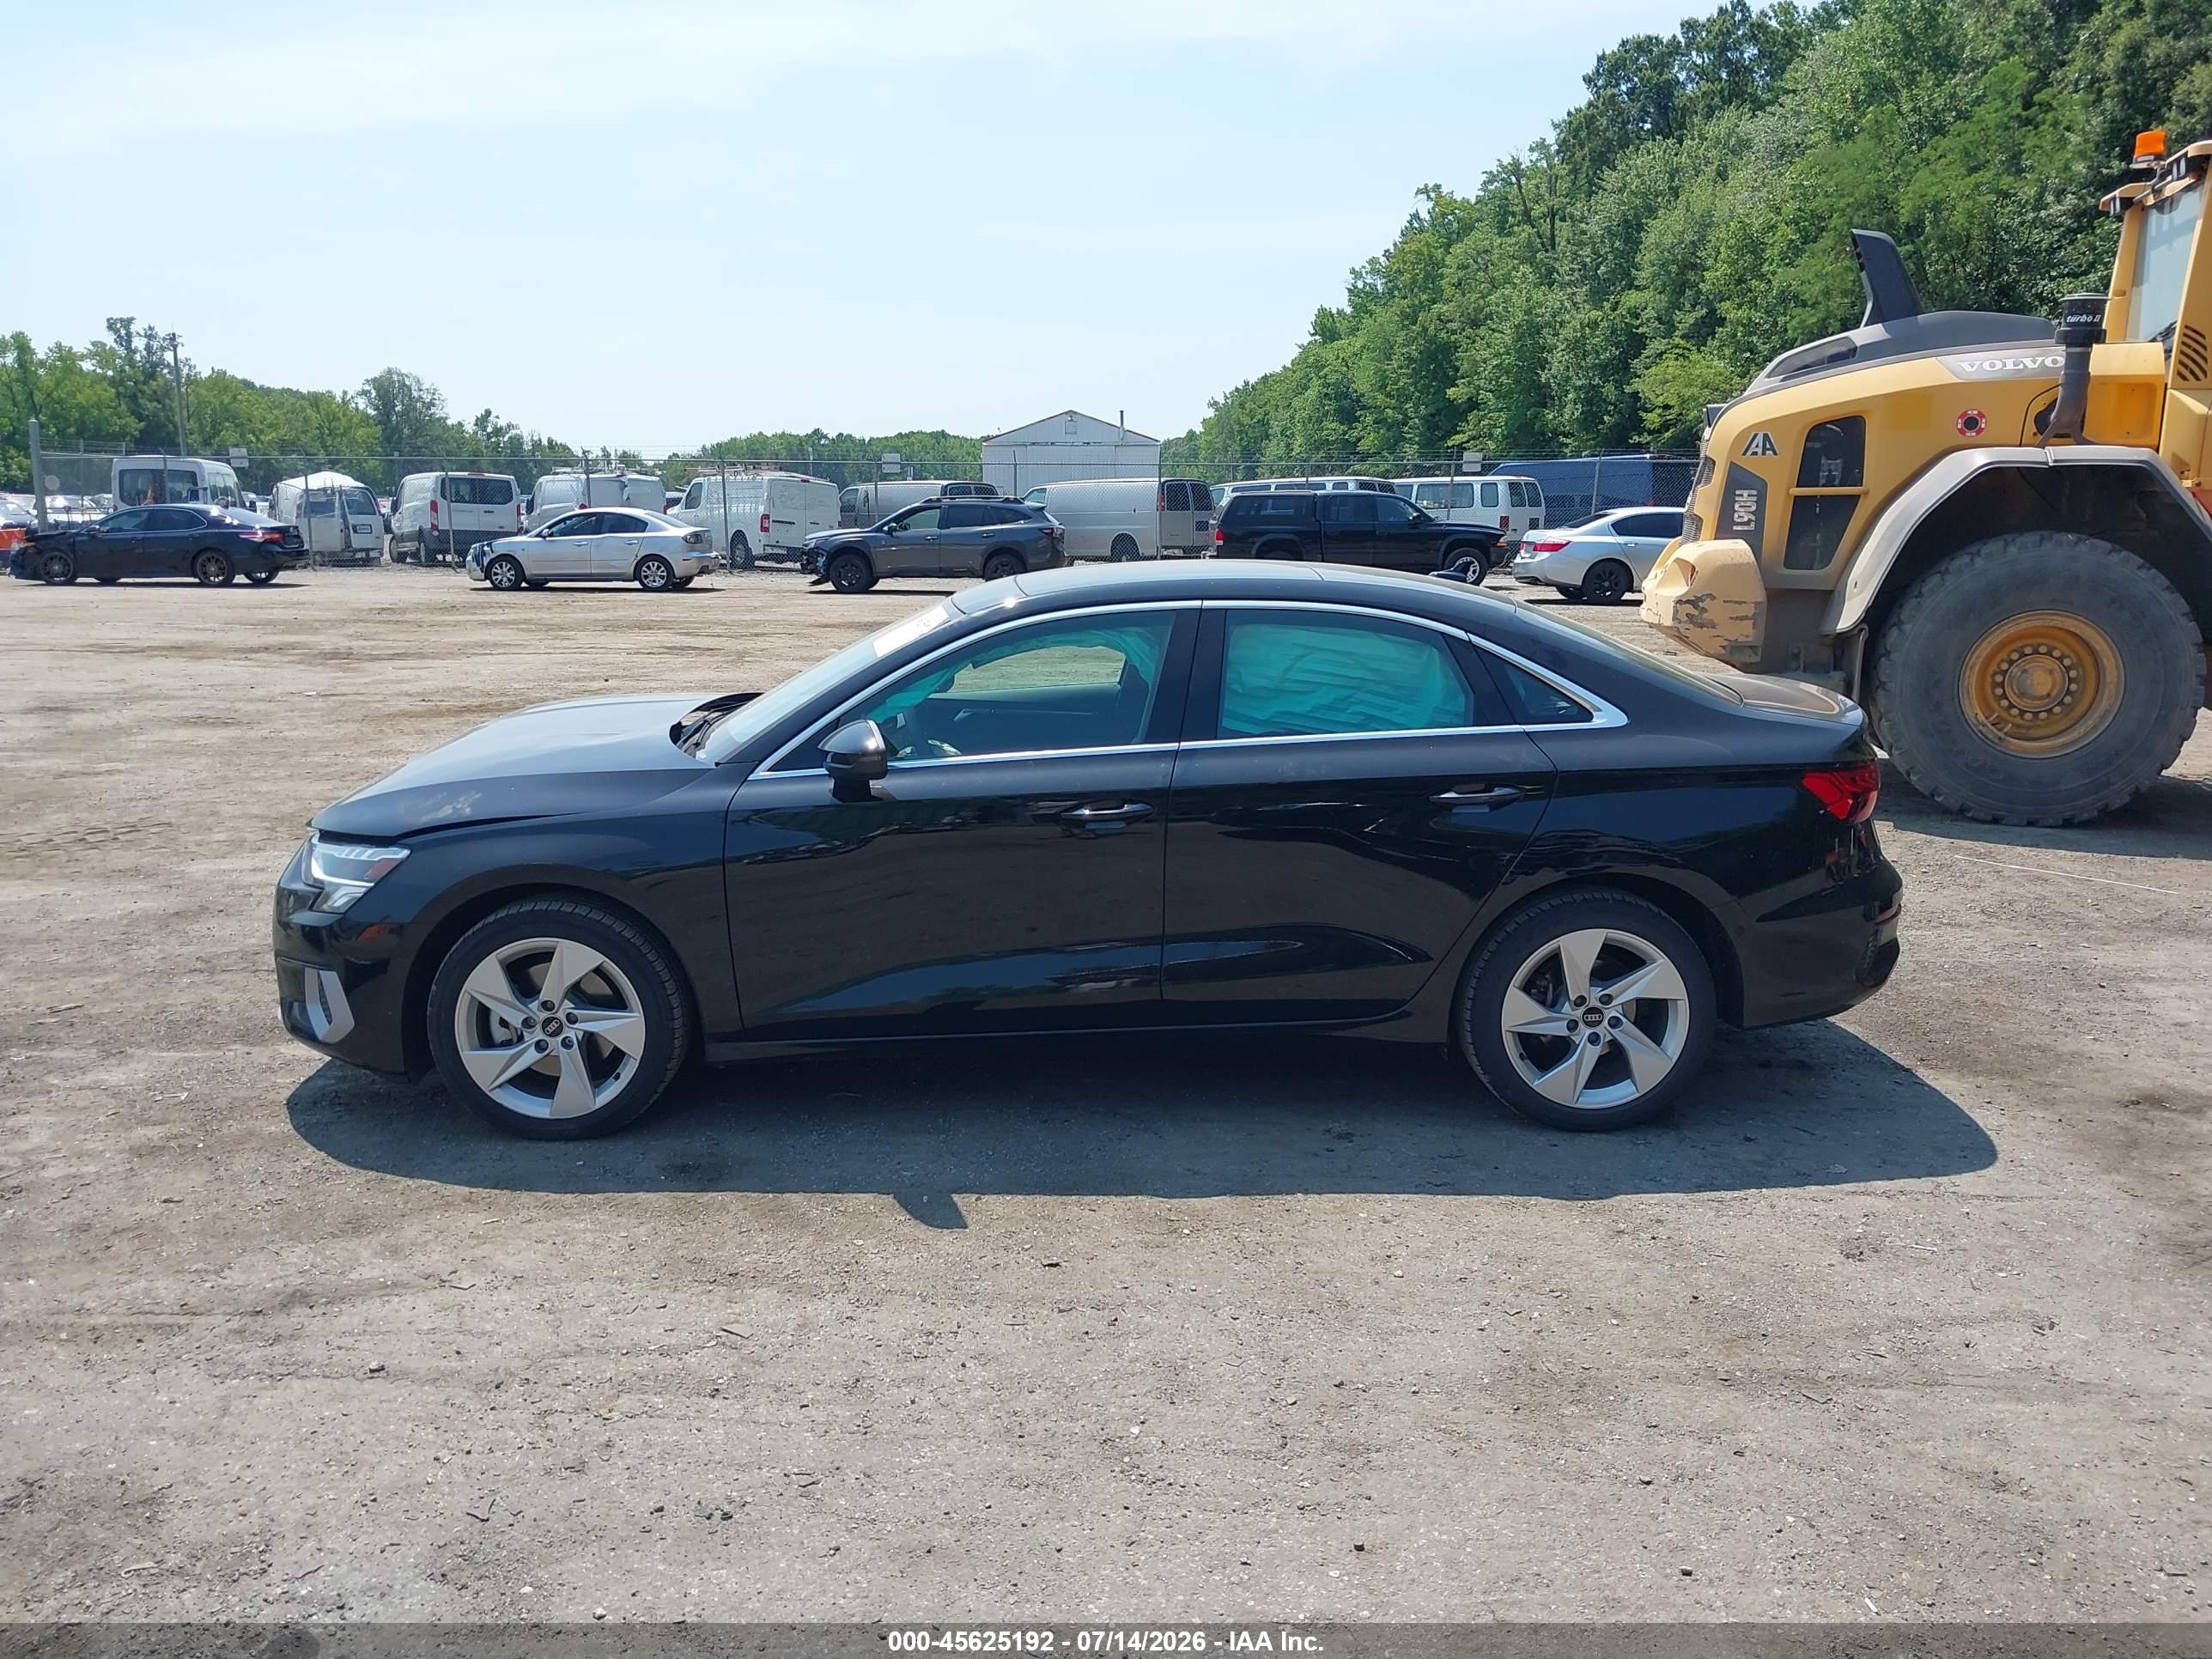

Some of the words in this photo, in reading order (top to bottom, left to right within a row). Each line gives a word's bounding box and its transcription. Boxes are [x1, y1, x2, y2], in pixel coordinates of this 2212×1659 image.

[2066, 313, 2093, 323] turbo
[1958, 356, 2064, 372] VOLVO
[1732, 489, 1758, 531] L90H
